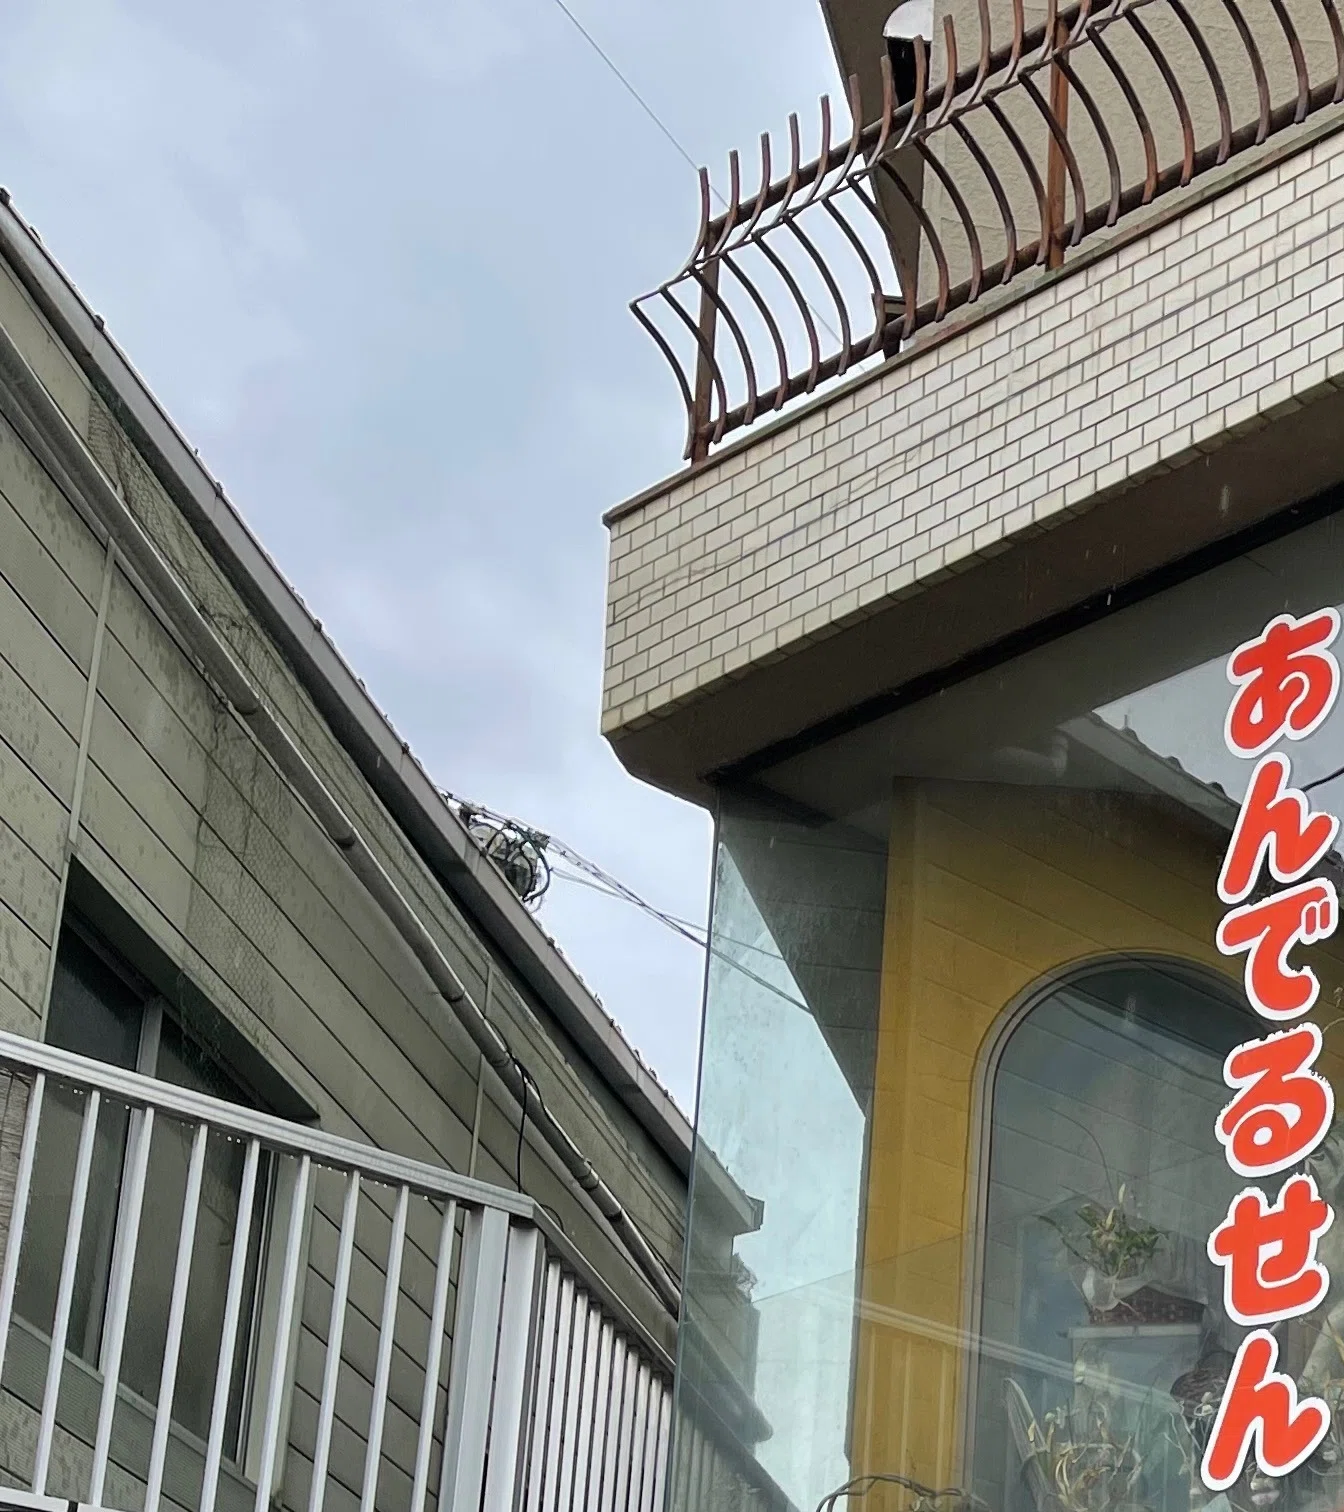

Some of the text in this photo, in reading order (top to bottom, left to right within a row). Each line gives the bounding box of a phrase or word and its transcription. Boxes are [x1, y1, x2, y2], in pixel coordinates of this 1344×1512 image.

[1201, 605, 1343, 1492] あんでるせん
